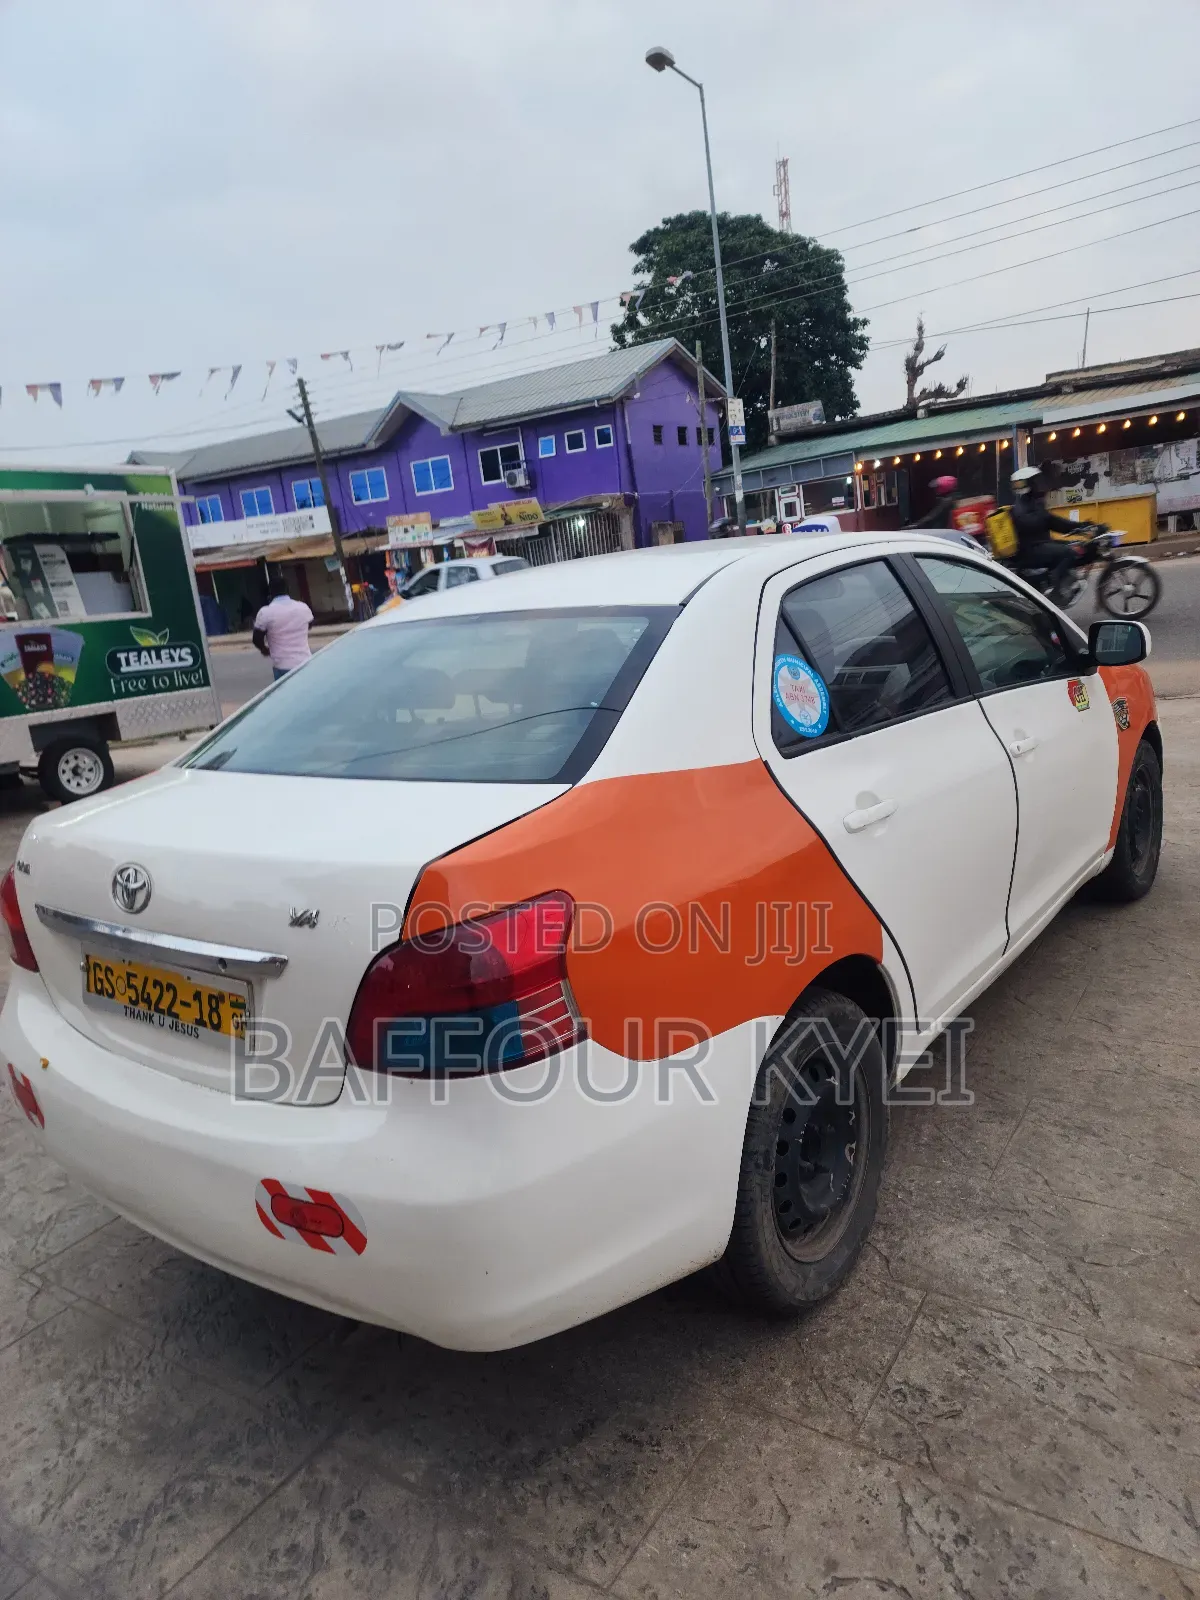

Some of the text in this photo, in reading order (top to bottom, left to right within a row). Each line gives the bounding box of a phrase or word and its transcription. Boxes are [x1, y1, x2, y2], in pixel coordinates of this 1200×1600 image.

[116, 647, 194, 671] TEALEYS
[110, 677, 149, 695] Free
[152, 674, 170, 690] to
[92, 961, 223, 1031] GS 5422-18
[123, 1005, 200, 1039] THANK U JESUS
